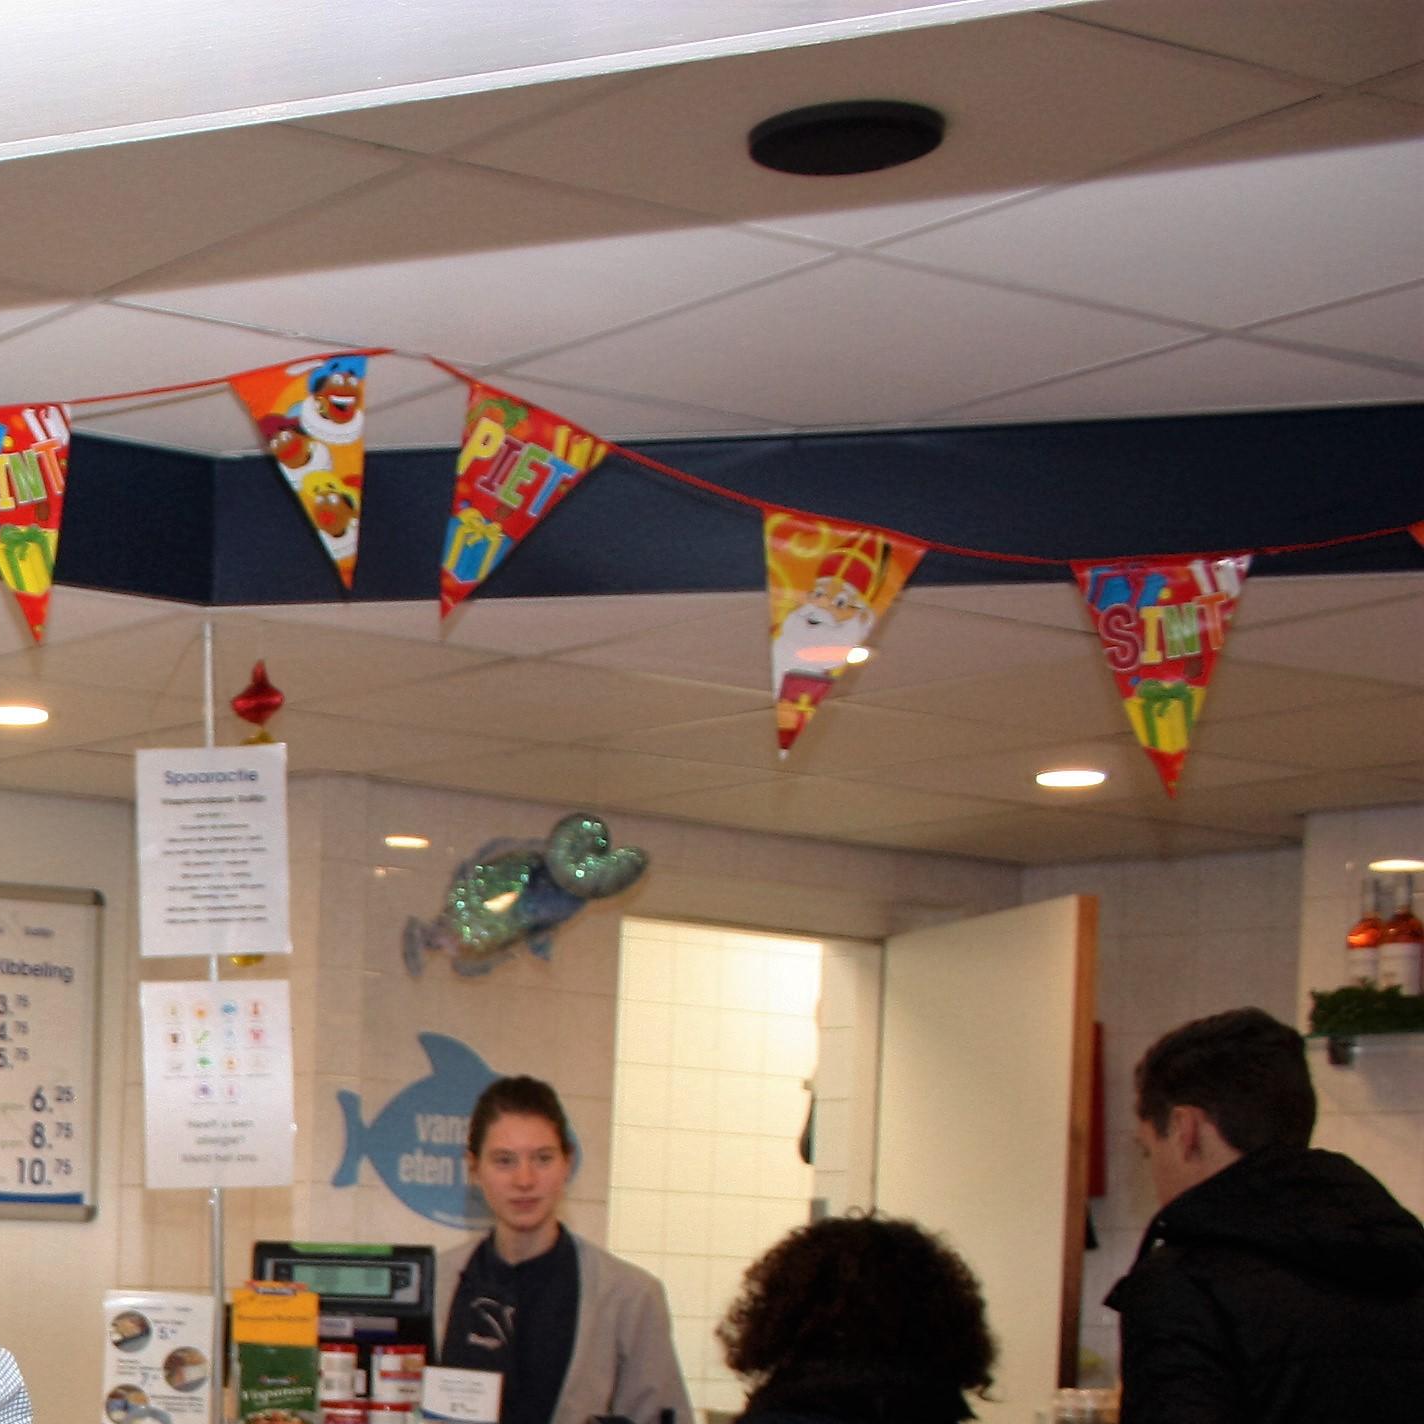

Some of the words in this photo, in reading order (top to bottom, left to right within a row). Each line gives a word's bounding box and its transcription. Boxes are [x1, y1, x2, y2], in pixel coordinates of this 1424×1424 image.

[457, 415, 579, 518] PIET
[1097, 592, 1231, 672] SINT
[399, 1147, 454, 1185] eten
